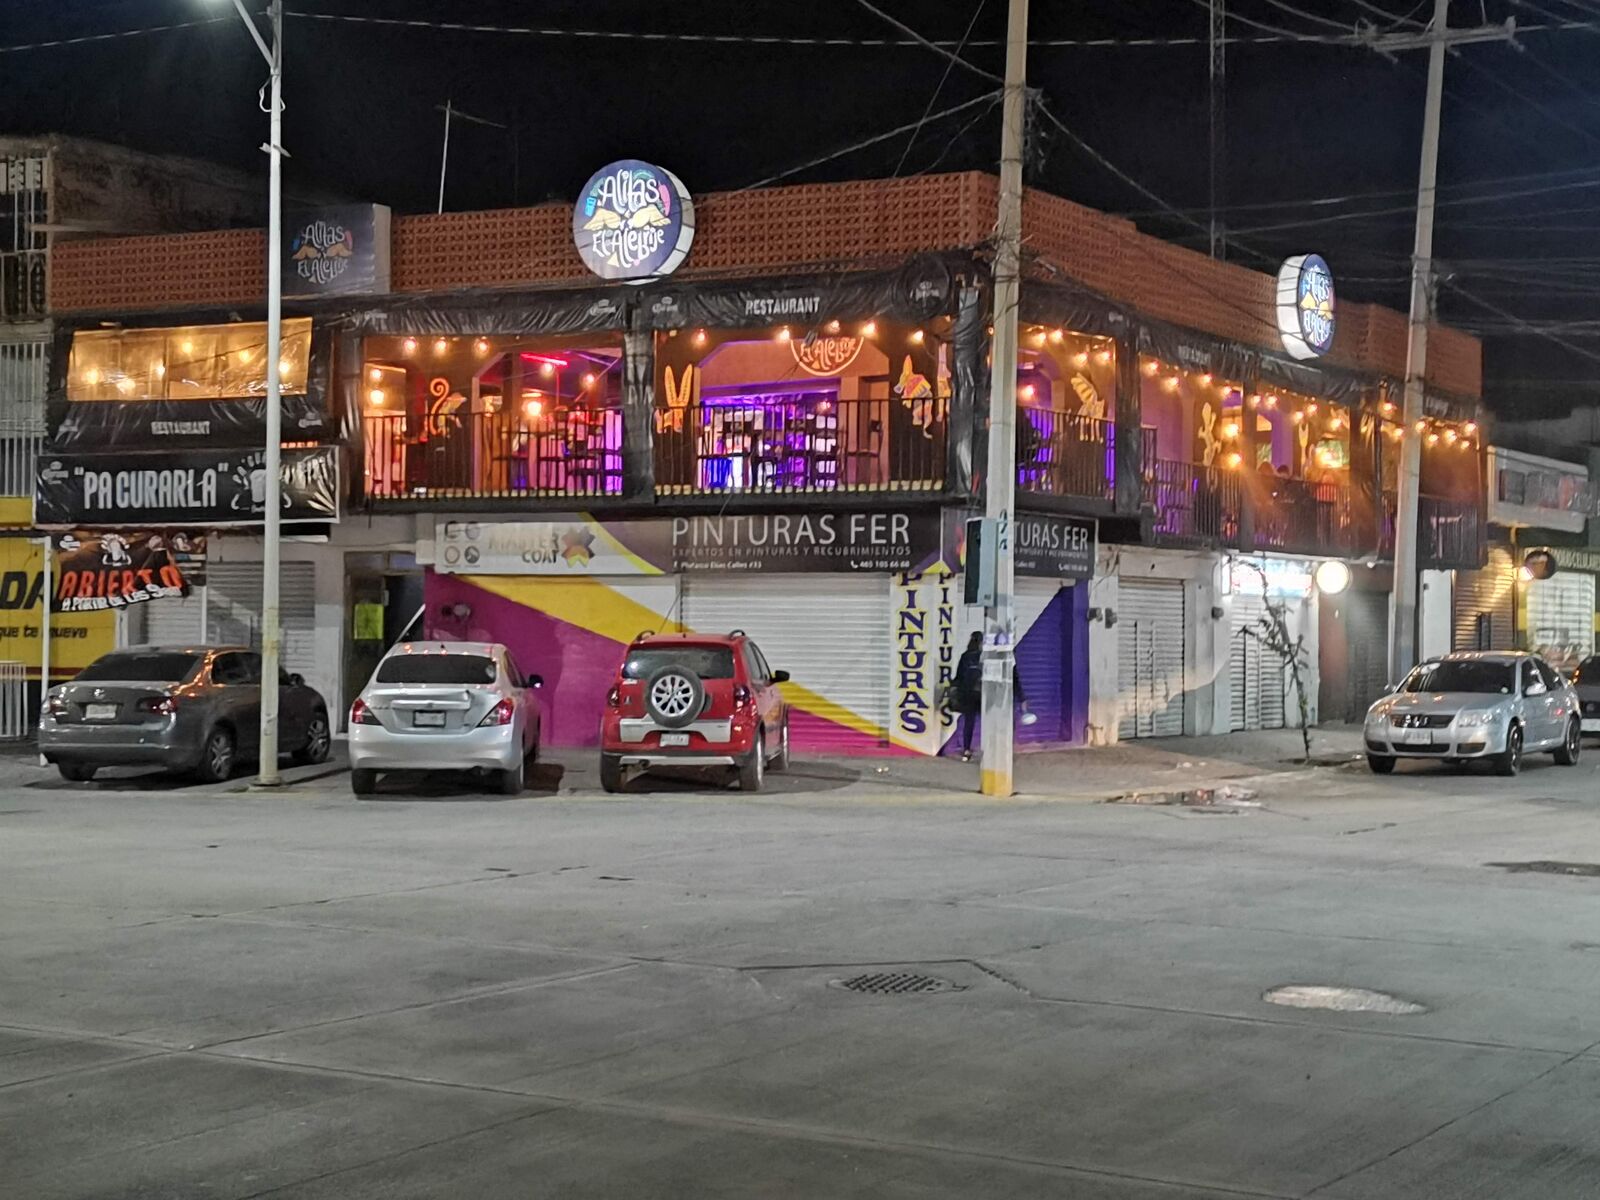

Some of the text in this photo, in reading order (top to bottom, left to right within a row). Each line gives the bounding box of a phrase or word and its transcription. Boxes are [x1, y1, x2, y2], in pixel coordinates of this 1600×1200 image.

[745, 297, 819, 316] RESTAURANT
[672, 514, 910, 546] PINTURAS FER
[1064, 526, 1088, 550] FER
[58, 565, 182, 600] ABIERTO
